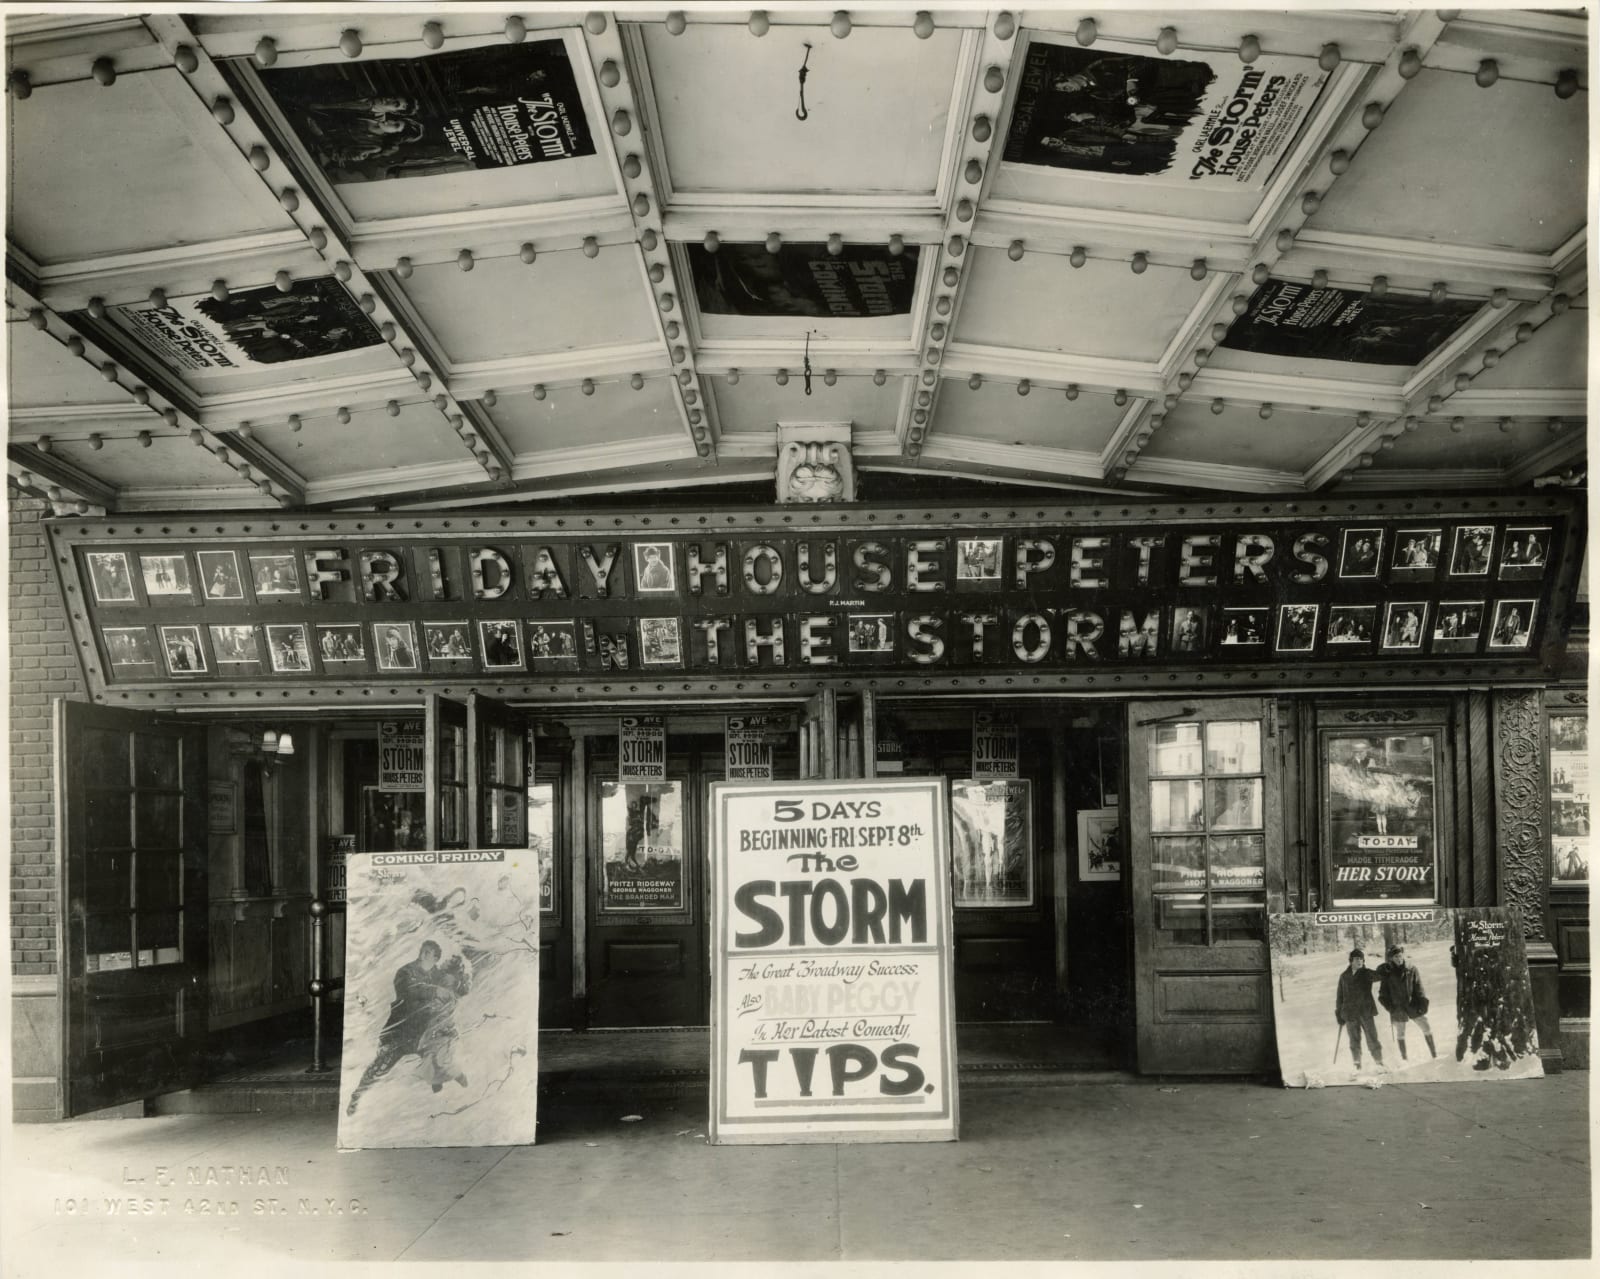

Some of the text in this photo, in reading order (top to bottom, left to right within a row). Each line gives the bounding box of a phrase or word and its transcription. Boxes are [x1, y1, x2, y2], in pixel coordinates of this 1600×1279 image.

[497, 104, 523, 134] House
[510, 132, 533, 161] Peters
[1199, 109, 1222, 137] LAEMMLE
[1216, 128, 1257, 177] House
[1242, 75, 1287, 129] Peters
[443, 126, 462, 153] JEWEL
[450, 118, 477, 160] UNIVERSAL
[1191, 136, 1208, 153] CARL
[137, 307, 215, 368] House Peters
[304, 532, 1331, 601] FRIDAY HOUSE PETERS
[694, 615, 838, 666] THE
[907, 609, 1161, 664] STORM
[382, 720, 422, 735] 5 AVE
[730, 716, 769, 730] 5 AVE
[383, 748, 424, 771] STORM
[623, 740, 663, 763] STORM
[730, 743, 770, 765] STORM
[976, 736, 1017, 760] STORM
[399, 772, 423, 784] PETERS
[622, 765, 663, 776] HOUSE PETERS
[730, 768, 770, 778] HOUSE PETERS
[992, 761, 1016, 773] PETERS
[773, 800, 882, 822] 5 DAYS
[339, 839, 357, 847] AVE
[740, 827, 828, 852] BEGINNING
[374, 851, 502, 864] COMING FRIDAY
[786, 851, 859, 873] The
[734, 878, 928, 948] STORM
[1318, 911, 1429, 922] COMING FRIDAY
[737, 963, 759, 980] The
[761, 962, 795, 979] Great
[797, 960, 865, 984] Broadway
[737, 980, 921, 1018] Also BABY PEGGY
[751, 1023, 768, 1041] In
[771, 1021, 800, 1041] Her
[800, 1019, 849, 1039] Latest
